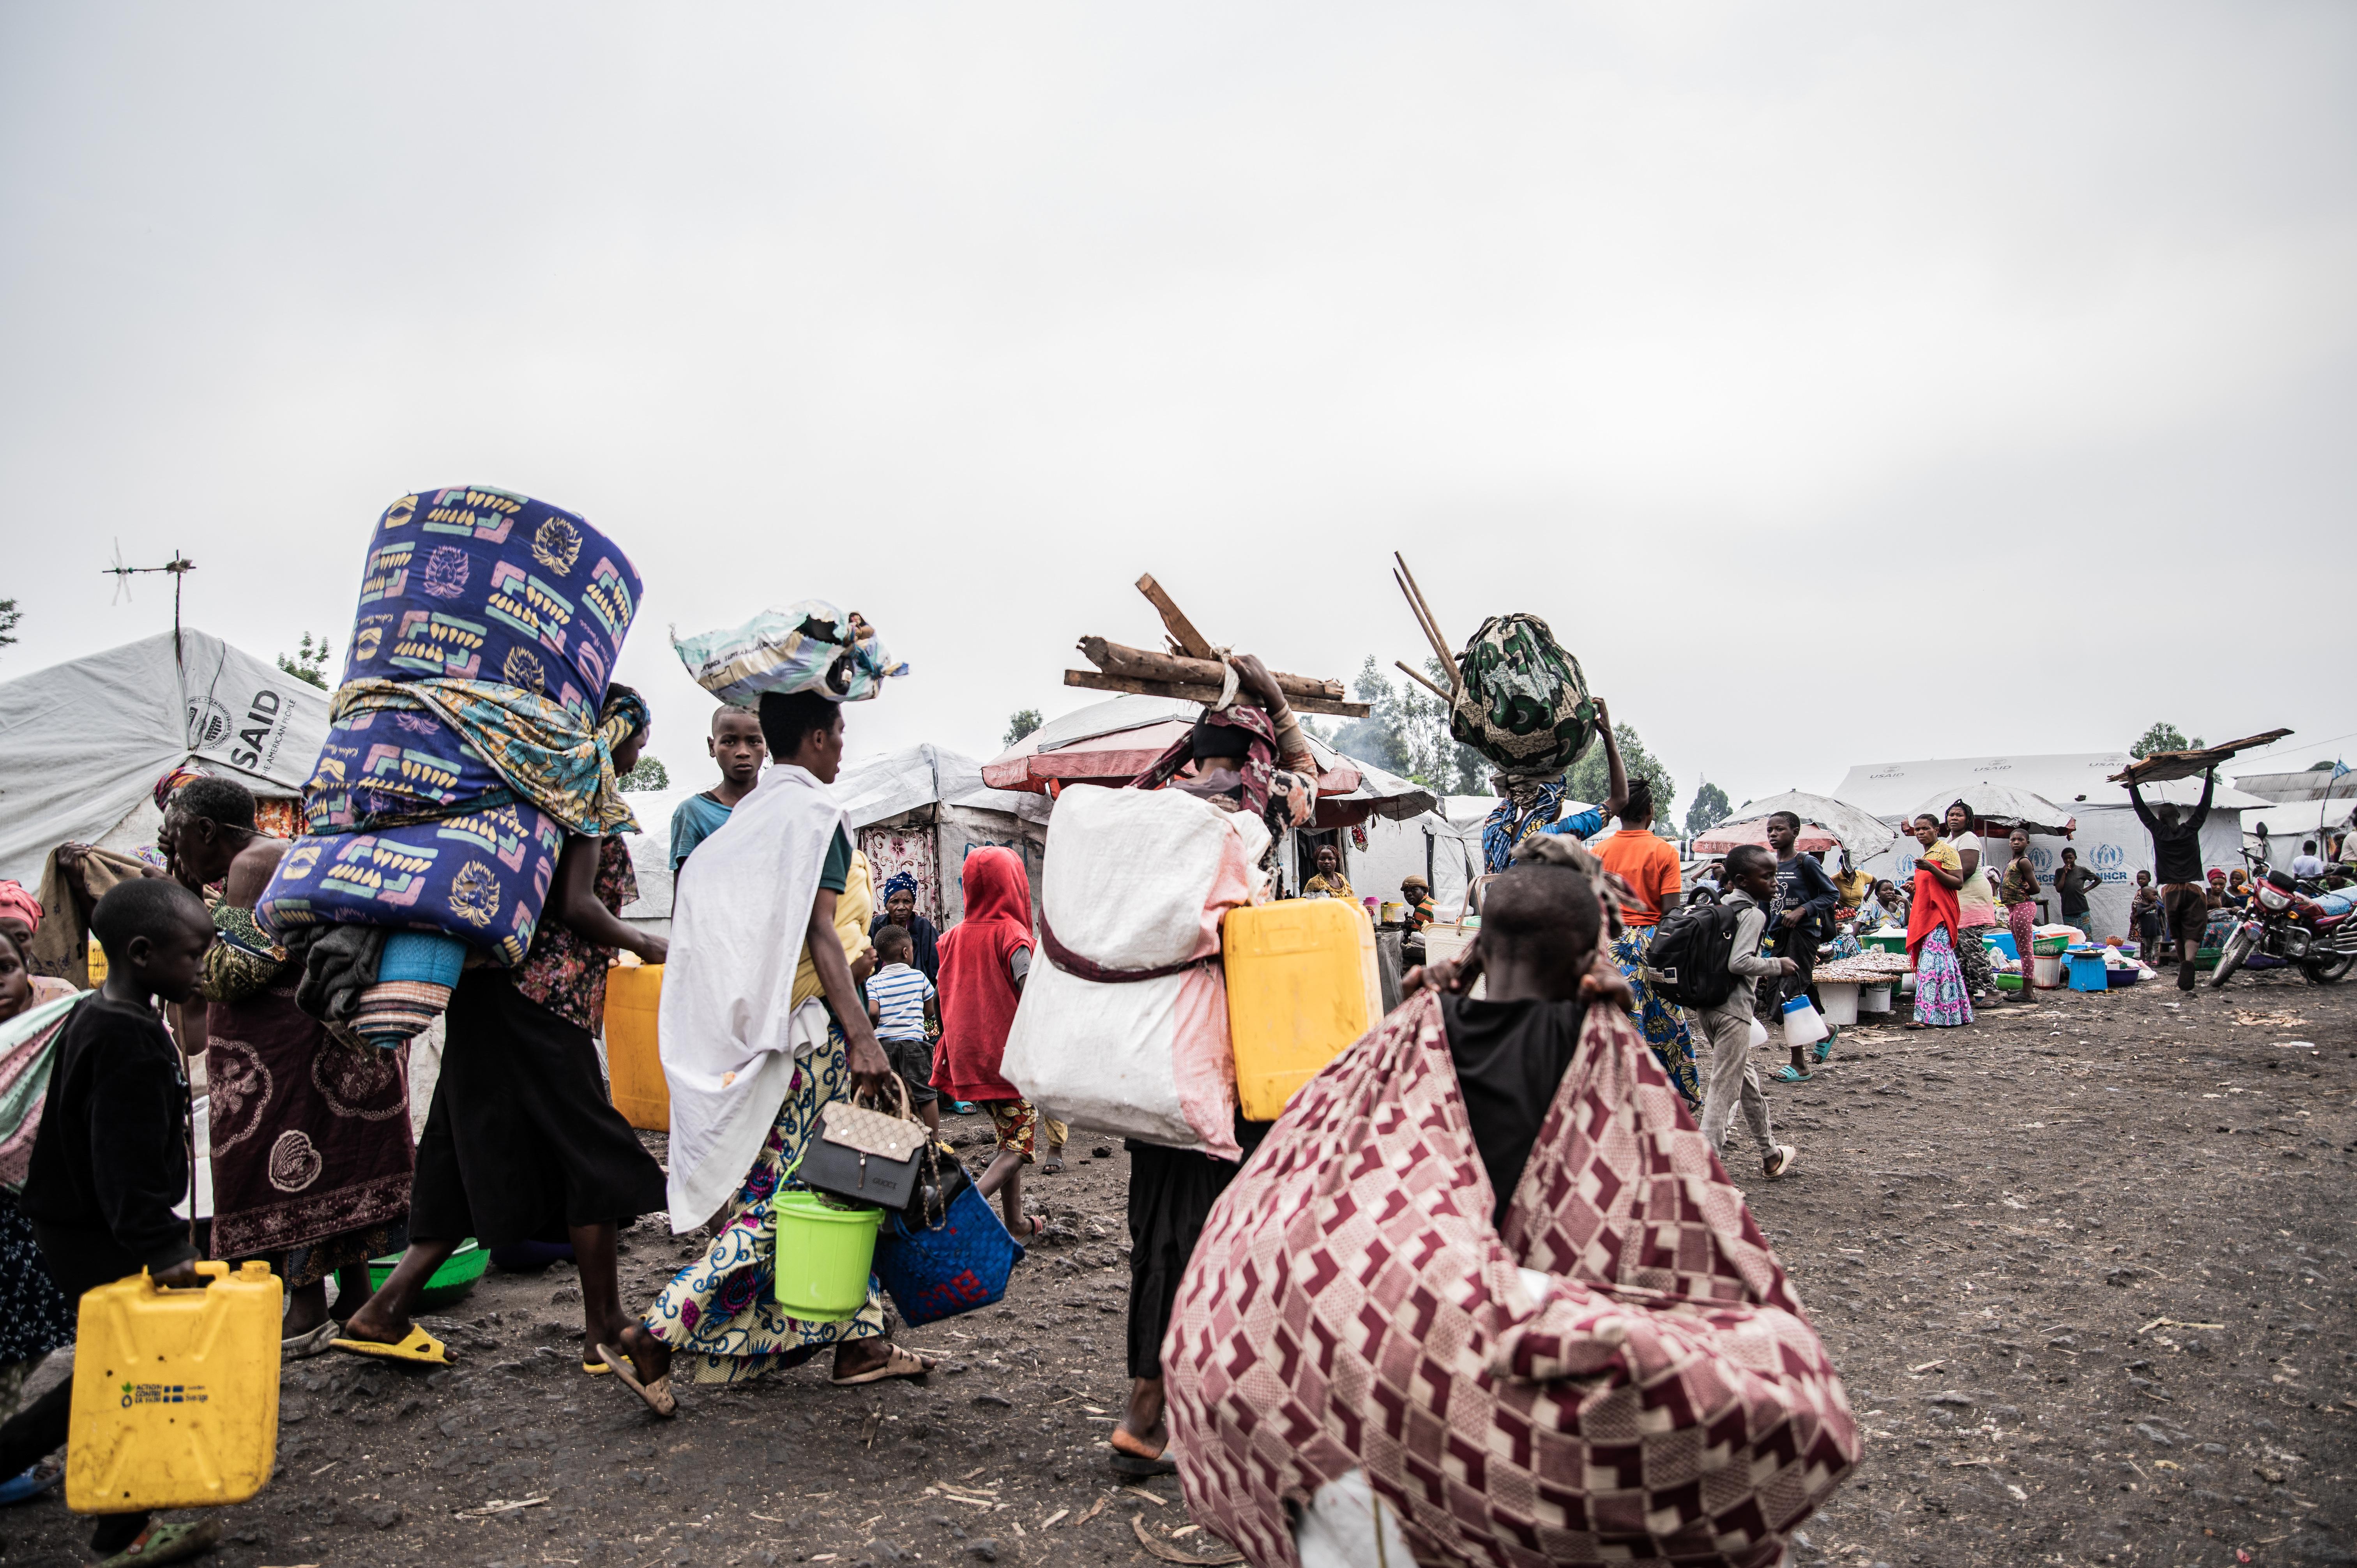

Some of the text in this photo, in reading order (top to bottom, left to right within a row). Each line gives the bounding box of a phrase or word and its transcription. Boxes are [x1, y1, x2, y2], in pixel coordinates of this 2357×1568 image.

[210, 699, 231, 731] DEVELOPMENT
[231, 690, 280, 770] SAID
[267, 725, 287, 764] AMERICAN
[283, 699, 297, 724] PEOPLE
[2096, 872, 2127, 880] NHCR
